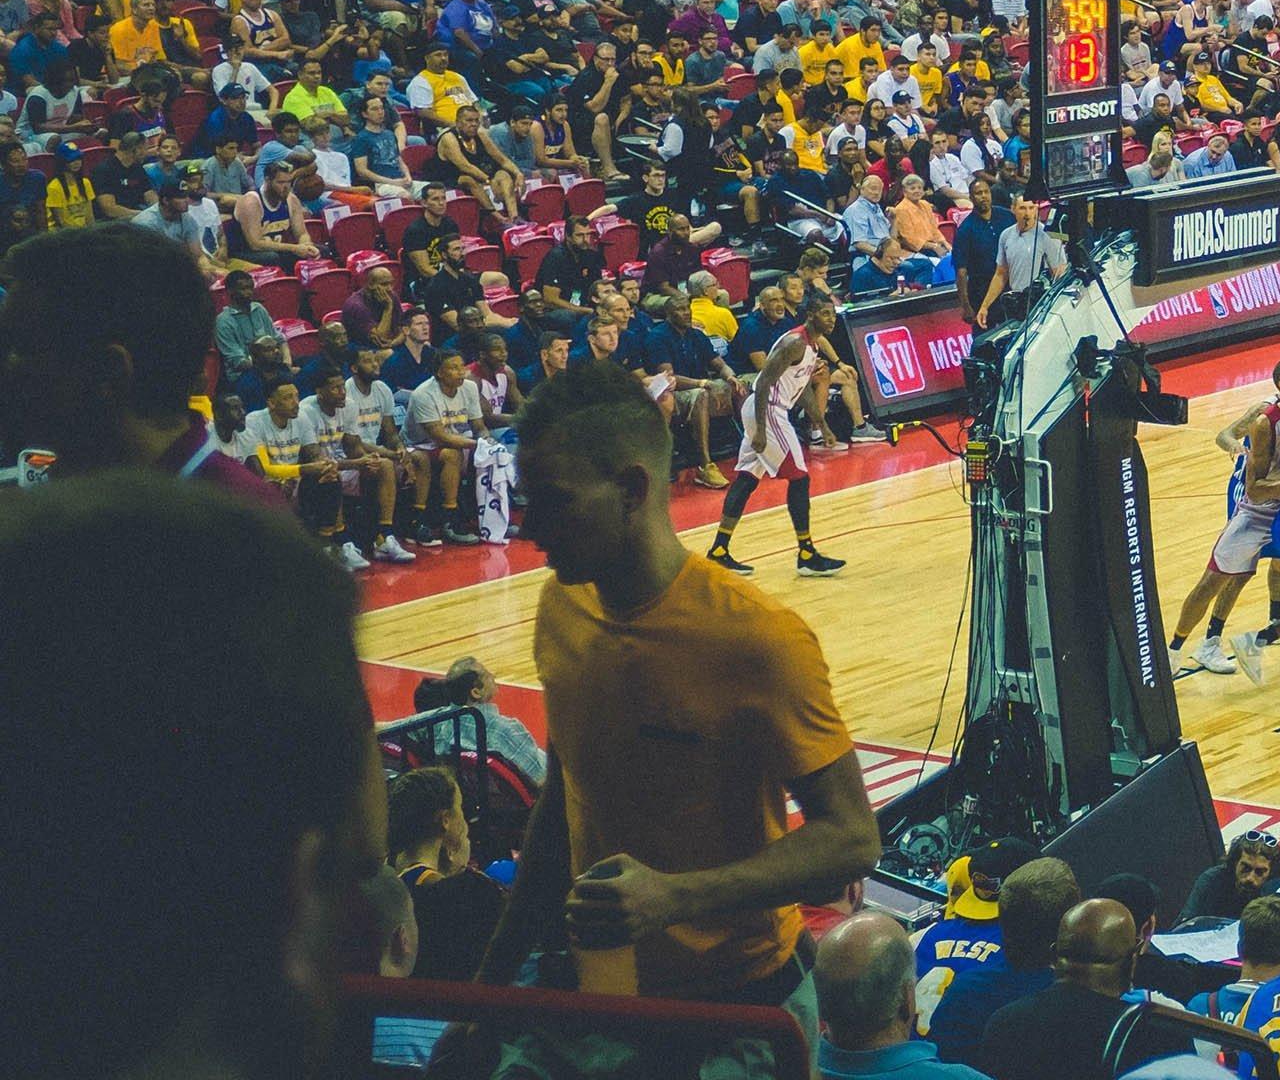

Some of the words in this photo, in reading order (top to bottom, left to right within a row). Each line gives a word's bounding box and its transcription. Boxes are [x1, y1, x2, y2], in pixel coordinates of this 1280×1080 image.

[1069, 35, 1099, 85] 13
[1069, 100, 1118, 122] TISSOT
[1172, 207, 1280, 262] #NBASummer
[886, 340, 915, 382] TV
[1120, 457, 1134, 494] MGM
[1124, 498, 1141, 566] RESORTS
[934, 939, 1001, 963] WEST
